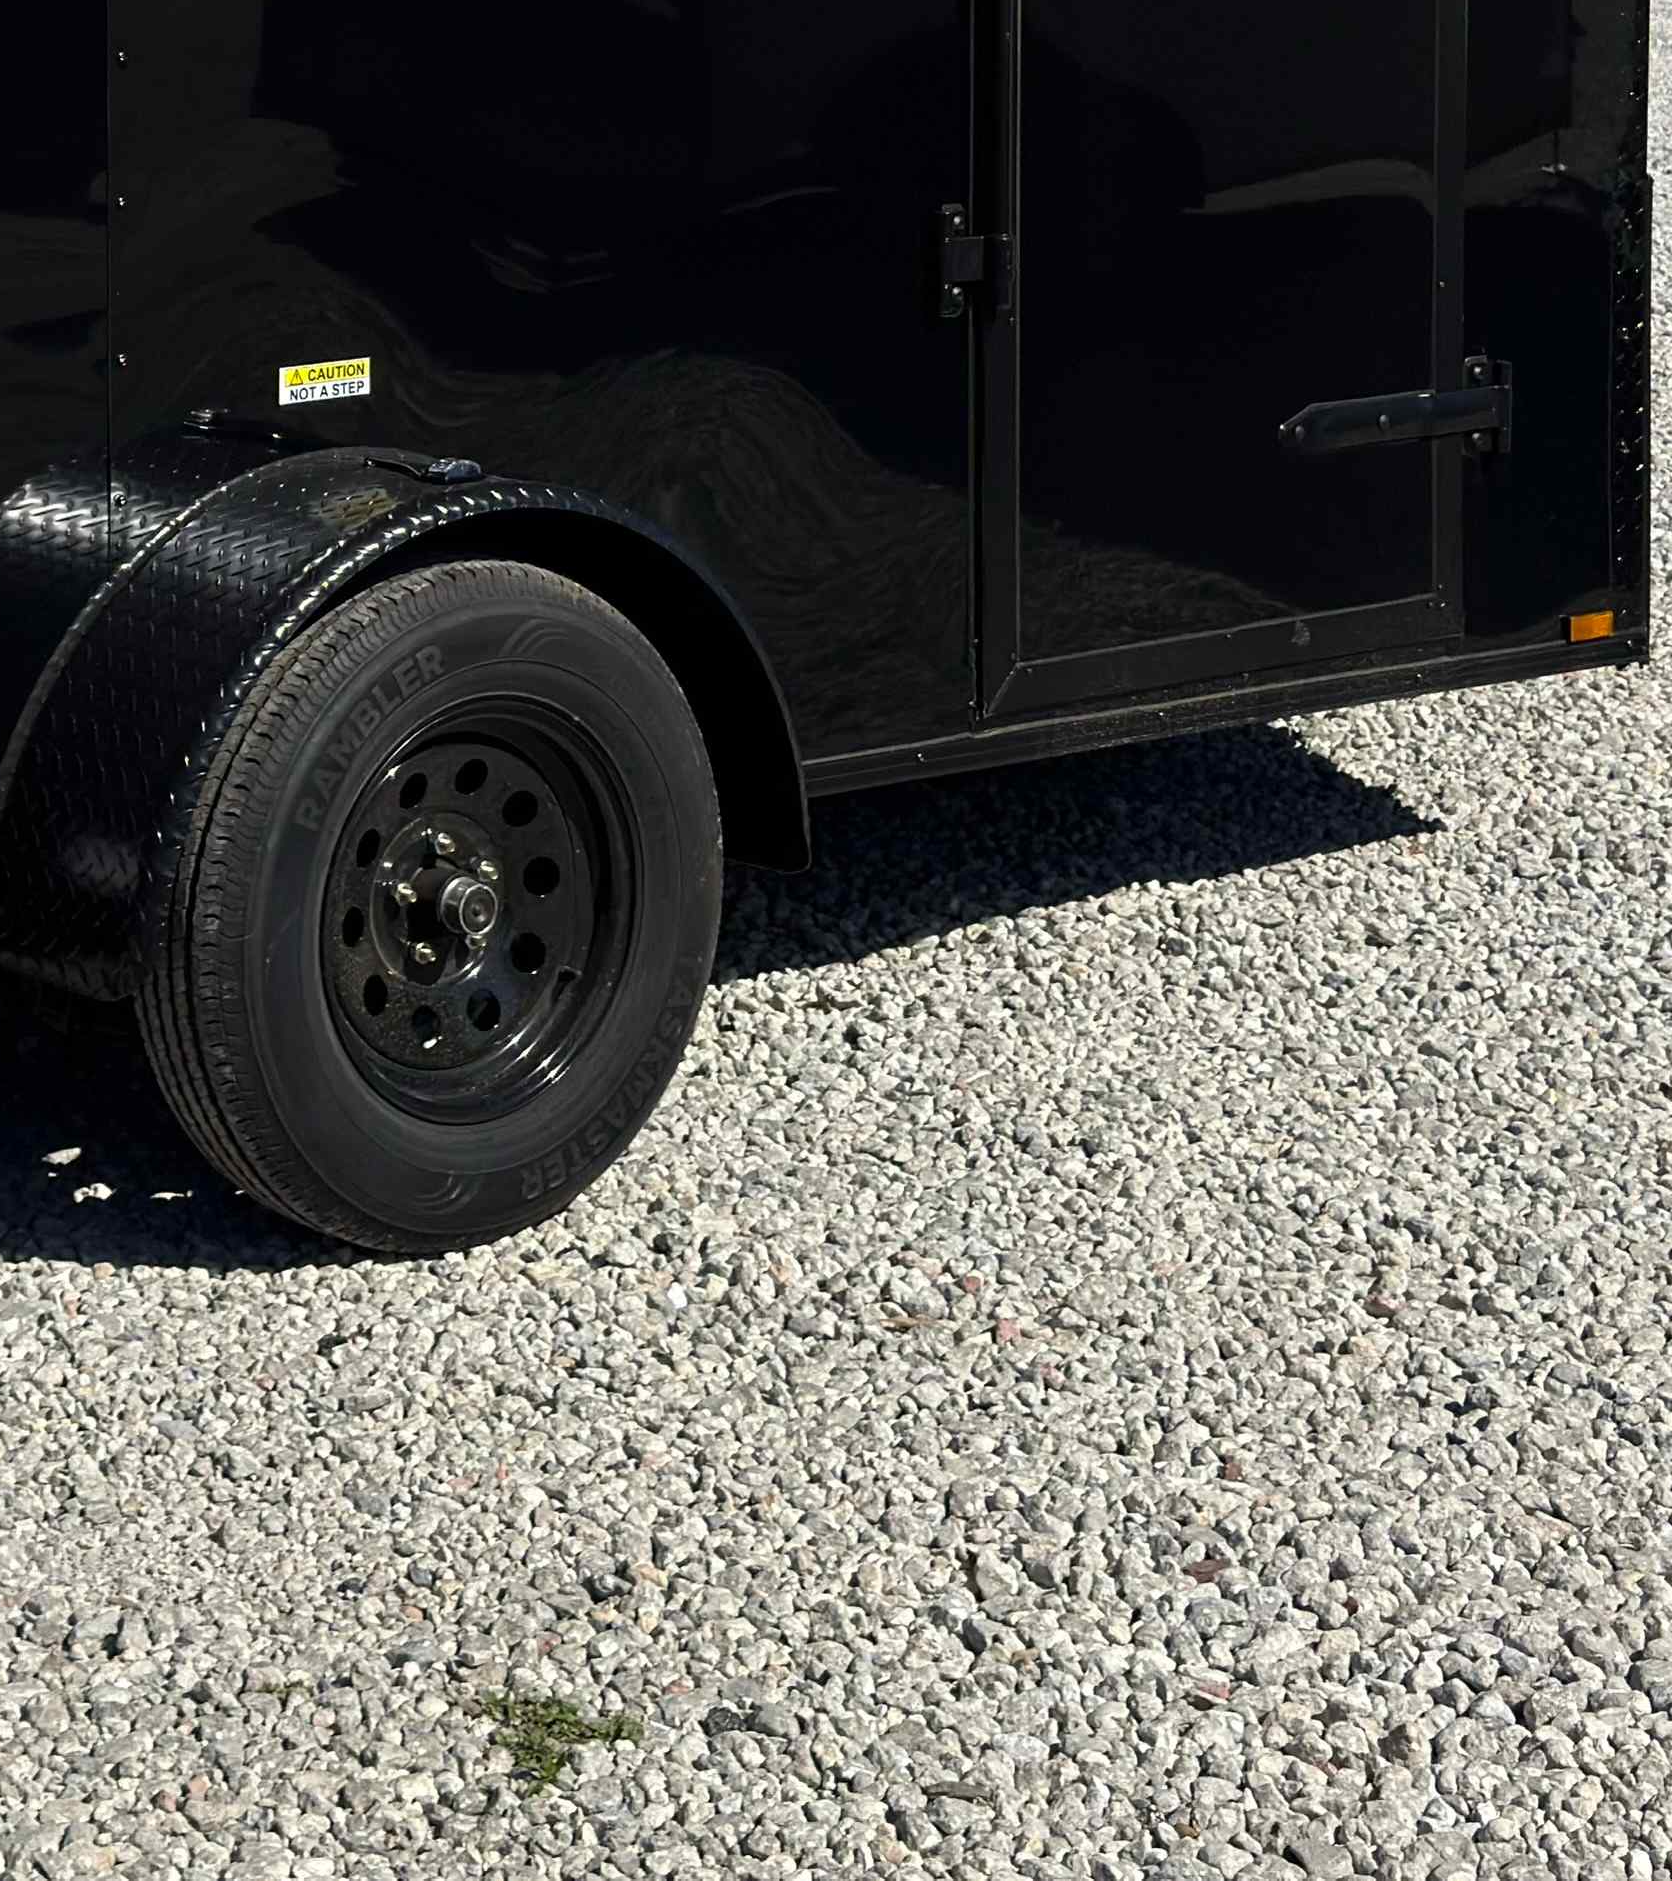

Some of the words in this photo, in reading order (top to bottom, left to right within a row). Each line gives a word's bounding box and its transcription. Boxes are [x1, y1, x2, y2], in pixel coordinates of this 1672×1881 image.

[290, 386, 316, 401] NOT
[320, 384, 329, 398] A
[332, 380, 365, 396] STEP
[307, 362, 365, 382] CAUTION
[296, 644, 445, 832] RAMBLER
[520, 951, 701, 1200] TASKMASTER
